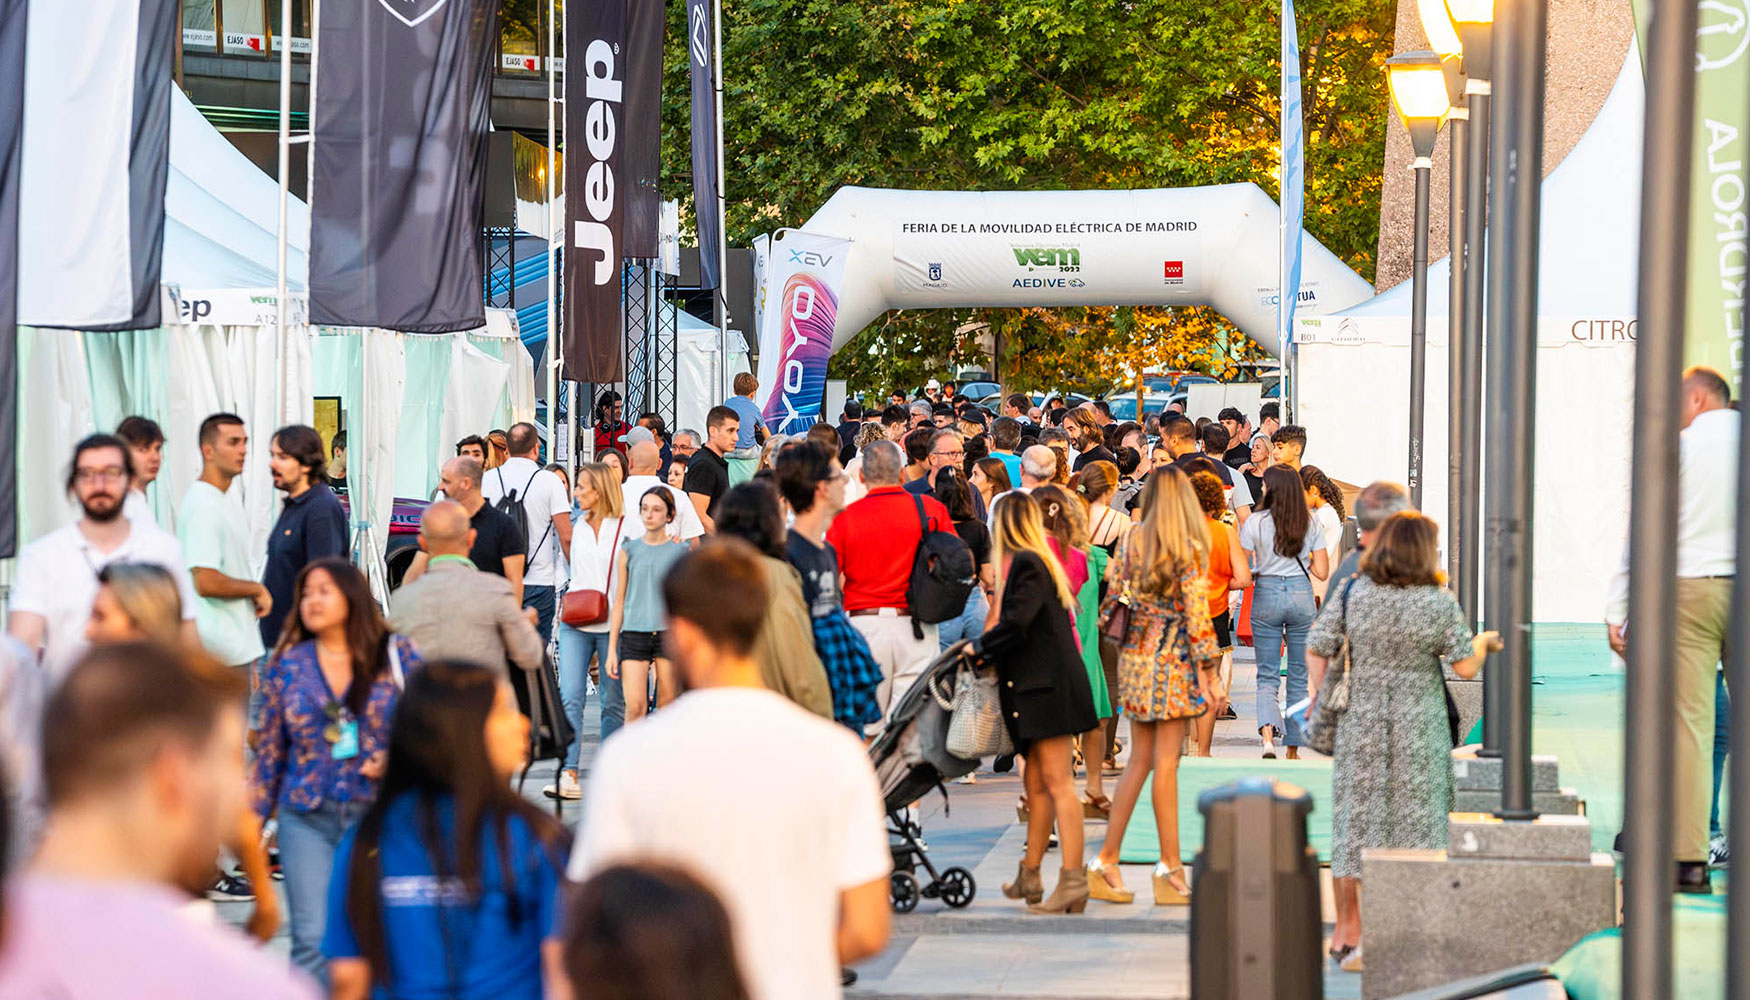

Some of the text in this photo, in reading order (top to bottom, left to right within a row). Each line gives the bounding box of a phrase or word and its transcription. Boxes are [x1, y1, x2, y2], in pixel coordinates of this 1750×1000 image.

[226, 35, 244, 46] EJASO
[575, 39, 622, 286] Jeep
[902, 221, 1197, 234] FERIA DE LA MOVILIDAD ELÉCTRICA DE MADRID
[788, 248, 833, 268] XEV
[1012, 247, 1080, 266] vem
[1012, 278, 1066, 288] AEDIVE
[778, 285, 815, 434] YOYO
